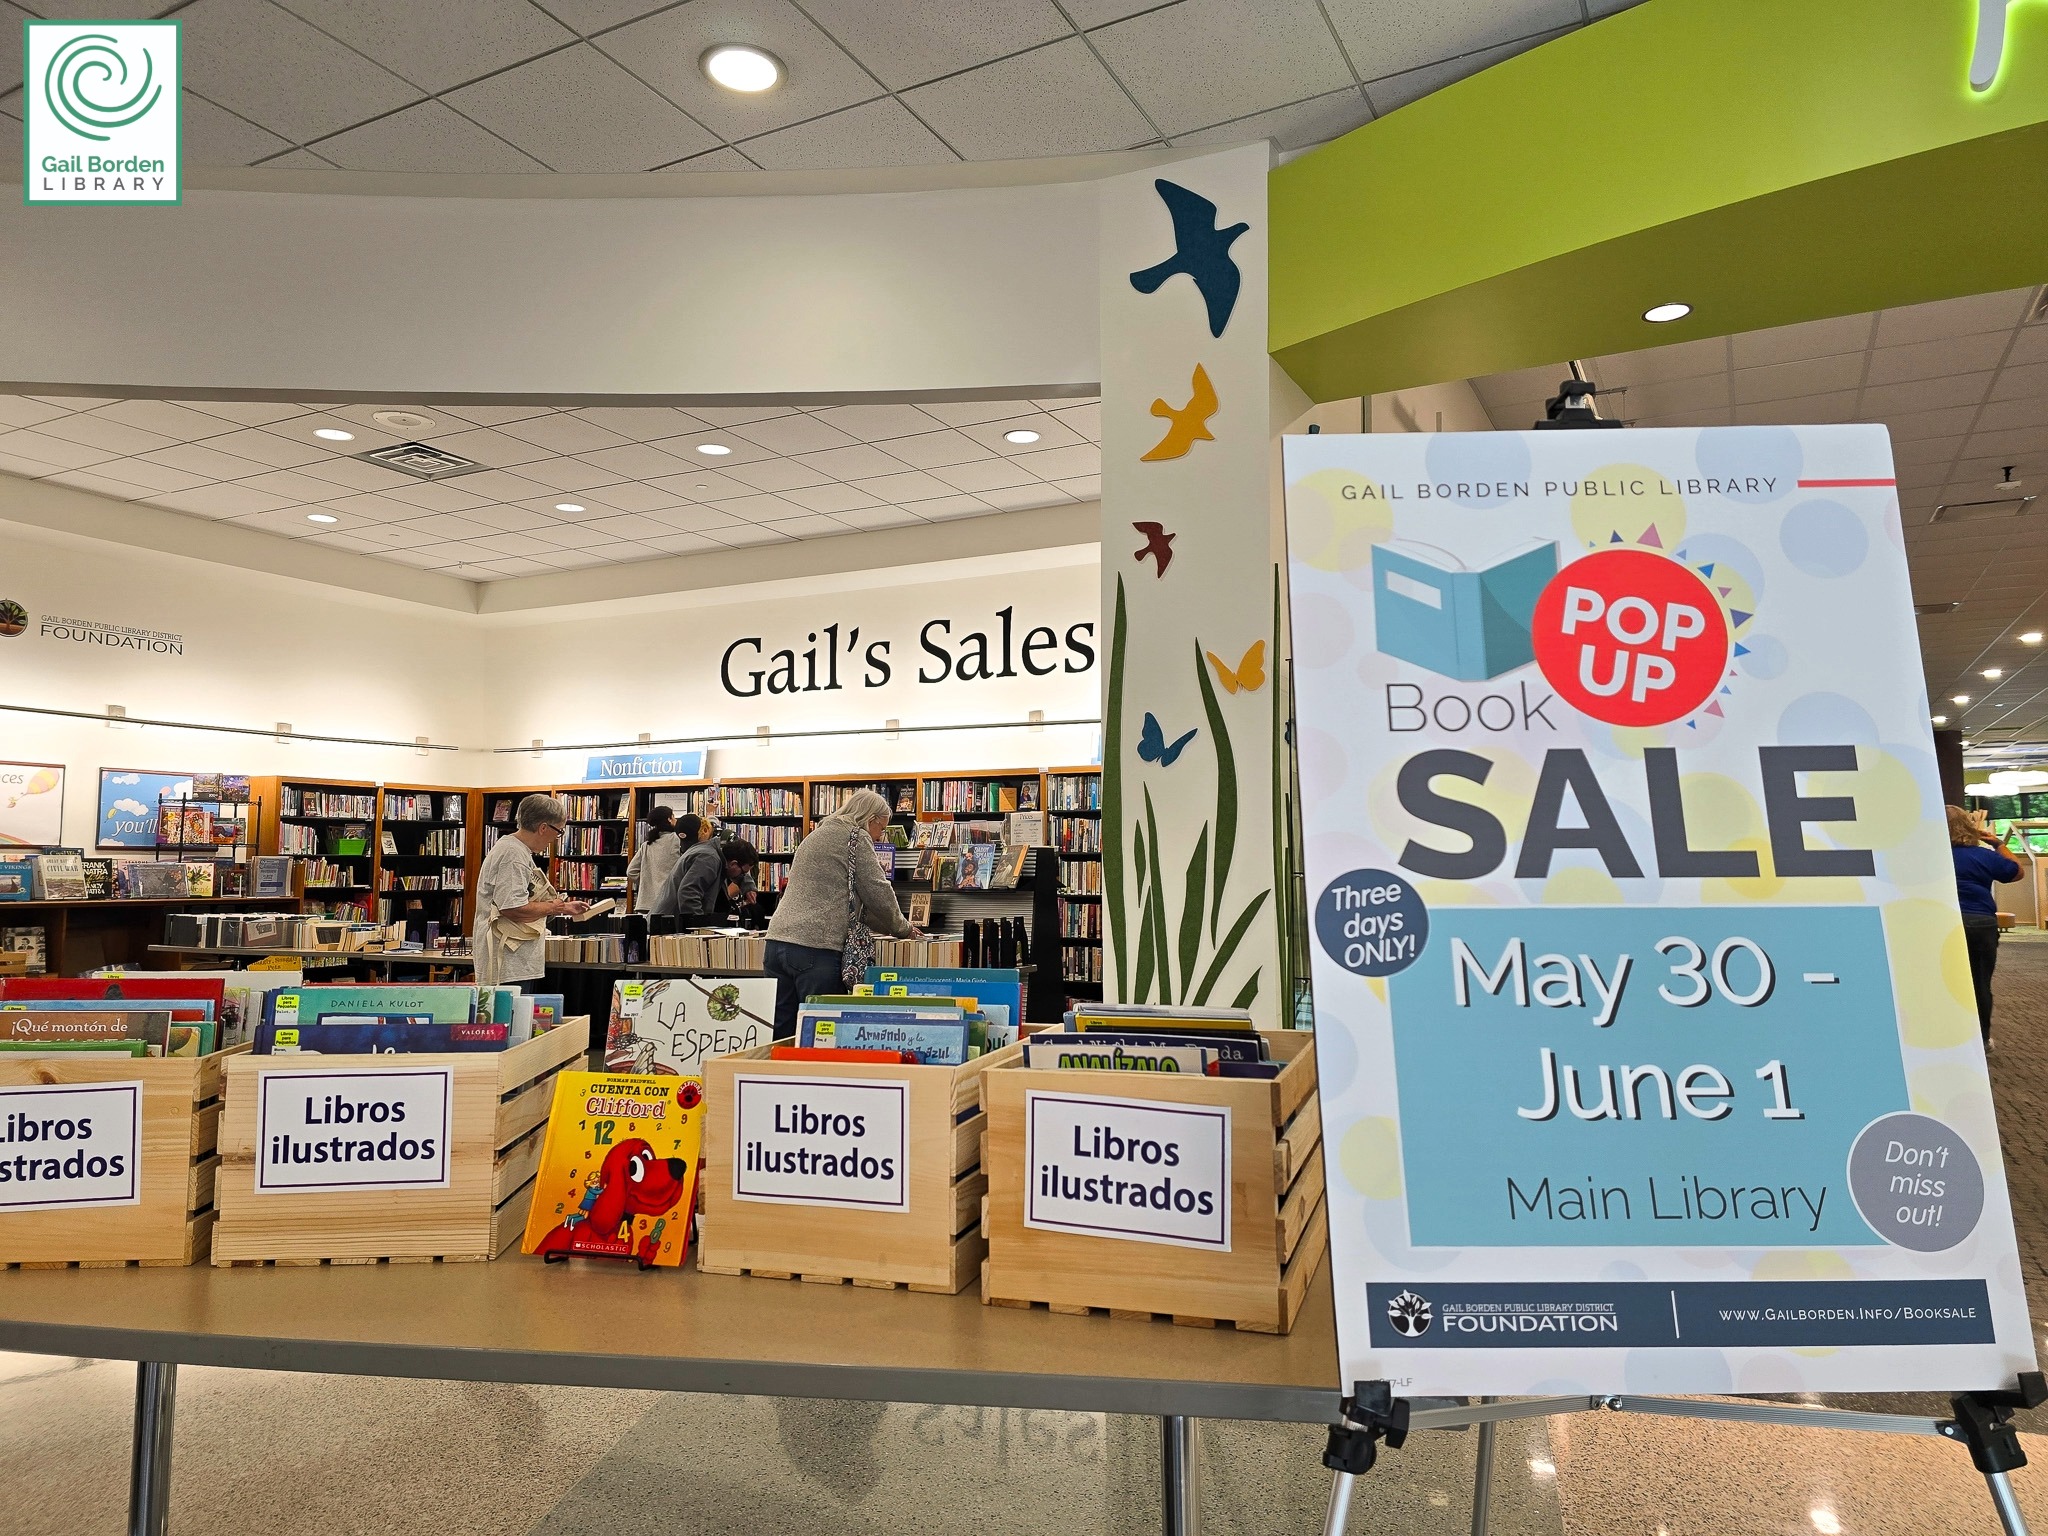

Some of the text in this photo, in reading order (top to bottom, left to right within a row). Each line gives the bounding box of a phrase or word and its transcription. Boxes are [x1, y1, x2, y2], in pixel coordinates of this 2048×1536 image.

[1341, 477, 1778, 500] GAIL BORDEN PUBLIC LIBRARY
[41, 614, 183, 642] GAIL BORDEN PUBLIC LIBRARY DISTRICT
[1561, 585, 1706, 652] POP
[40, 624, 183, 656] FOUNDATION
[720, 605, 1095, 698] Gail's Sales
[1578, 644, 1676, 703] UP
[1386, 681, 1557, 732] Book
[600, 755, 683, 777] Nonfiction
[1396, 745, 1876, 880] SALE
[111, 818, 158, 837] you'll
[1331, 883, 1402, 911] Three
[1343, 912, 1404, 940] days
[1344, 933, 1415, 968] ONLY!
[1450, 935, 1840, 1028] May 30 -
[331, 1000, 384, 1008] DANIELA
[11, 1018, 128, 1035] ¡Qué montón de
[657, 1001, 686, 1031] LA
[671, 1024, 758, 1065] ESPERA
[855, 1026, 906, 1042] Armando
[908, 1036, 914, 1046] y
[925, 1047, 950, 1059] azul
[580, 1088, 586, 1097] 3
[590, 1084, 670, 1097] CUENTA CON
[1516, 1047, 1806, 1121] June 1
[305, 1094, 406, 1124] Libros
[585, 1097, 667, 1120] Clifford
[680, 1114, 688, 1124] 9
[628, 1122, 636, 1132] 8
[656, 1122, 662, 1131] 2
[775, 1104, 866, 1137] Libros
[594, 1120, 616, 1145] 12
[272, 1132, 436, 1164] ilustrados
[584, 1151, 592, 1159] 5
[674, 1140, 682, 1150] 7
[1074, 1125, 1180, 1166] Libros
[1885, 1140, 1949, 1168] Don't
[747, 1142, 894, 1180] ilustrados
[570, 1168, 578, 1178] 6
[568, 1188, 576, 1198] 4
[1042, 1164, 1214, 1216] ilustrados
[1889, 1173, 1946, 1198] miss
[555, 1202, 564, 1214] 2
[1507, 1174, 1827, 1232] Main Library
[639, 1220, 648, 1230] 3
[671, 1212, 679, 1221] 2
[1896, 1204, 1943, 1227] out!
[618, 1220, 630, 1243] 4
[582, 1243, 627, 1252] SCHOLASTIC
[664, 1242, 672, 1252] 9
[1442, 1303, 1614, 1313] GAIL BORDEN PUBLIC LIBRARY DISTRICT
[1442, 1314, 1618, 1332] FOUNDATION
